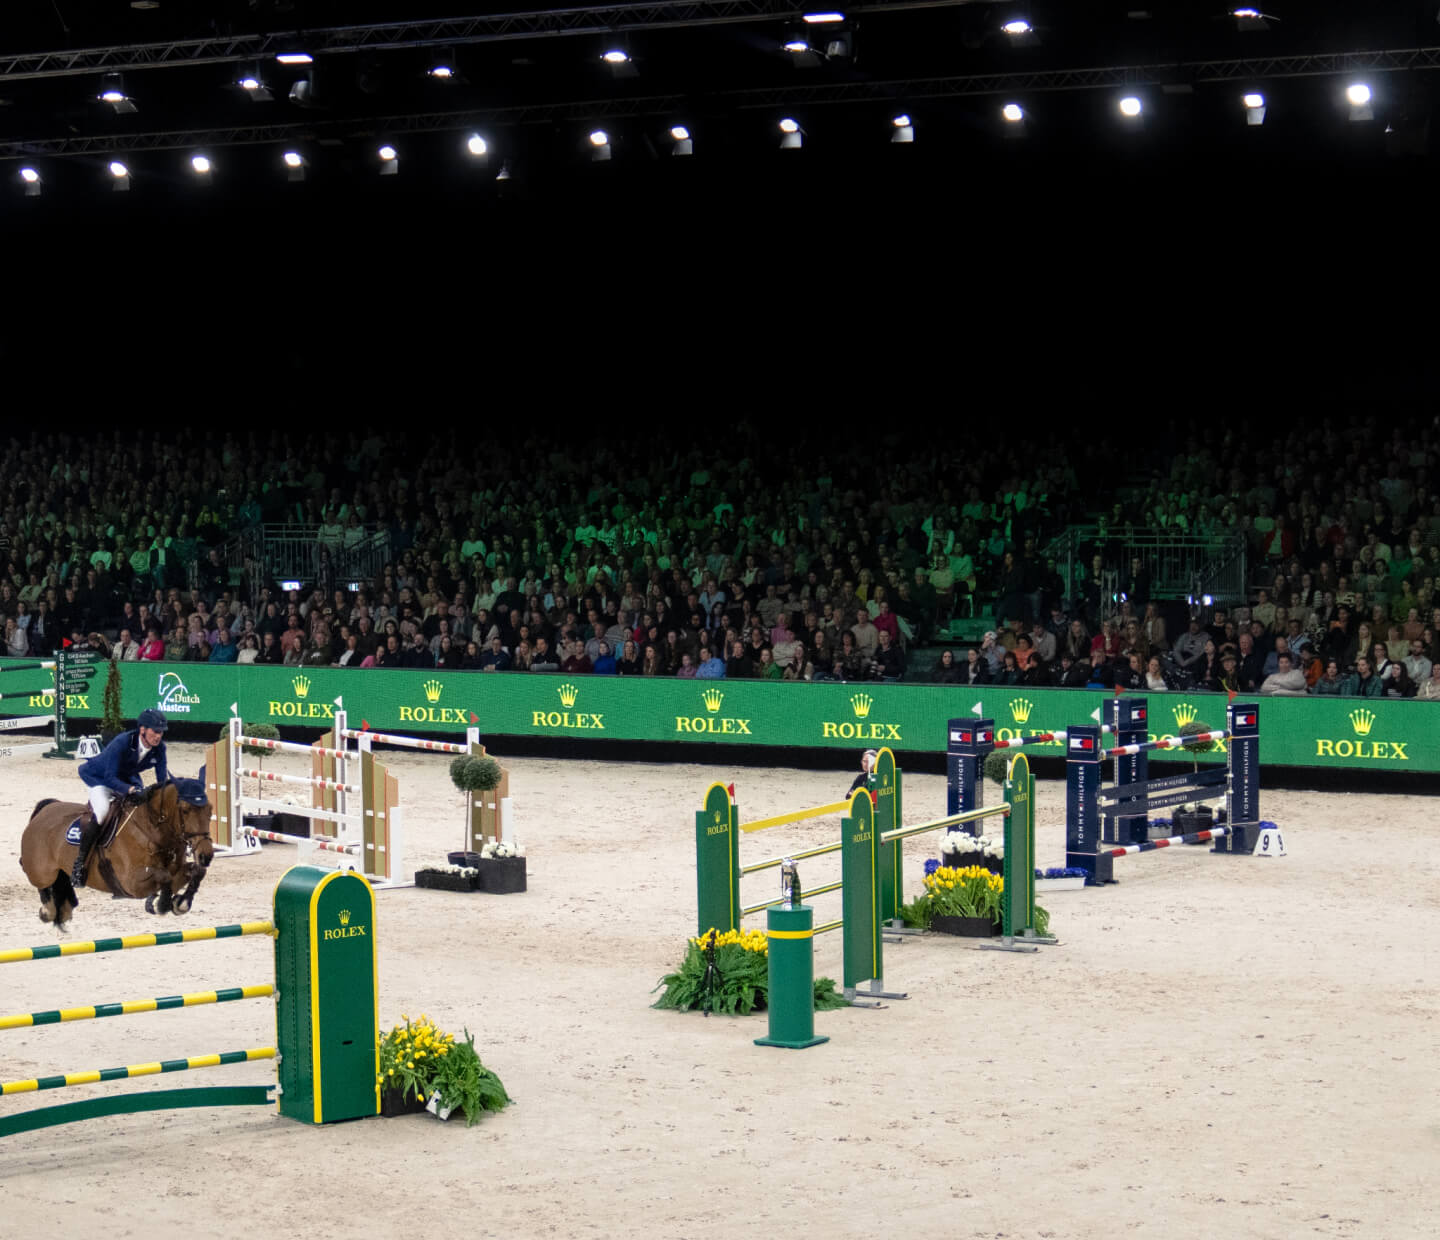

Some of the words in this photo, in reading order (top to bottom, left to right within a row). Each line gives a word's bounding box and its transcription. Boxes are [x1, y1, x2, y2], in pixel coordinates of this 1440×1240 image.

[29, 694, 90, 710] ROEX
[157, 701, 190, 712] Masters
[174, 693, 200, 704] Dutch
[269, 701, 334, 718] ROLEX
[400, 706, 467, 723] ROLEX
[0, 719, 18, 729] SLAM
[532, 711, 605, 729] ROLEX
[676, 717, 752, 735] ROLEX
[822, 722, 902, 740] ROLEX
[1316, 739, 1409, 760] ROLEX
[707, 823, 729, 836] ROLEX
[1262, 834, 1270, 851] 9
[324, 926, 366, 940] ROLEX
